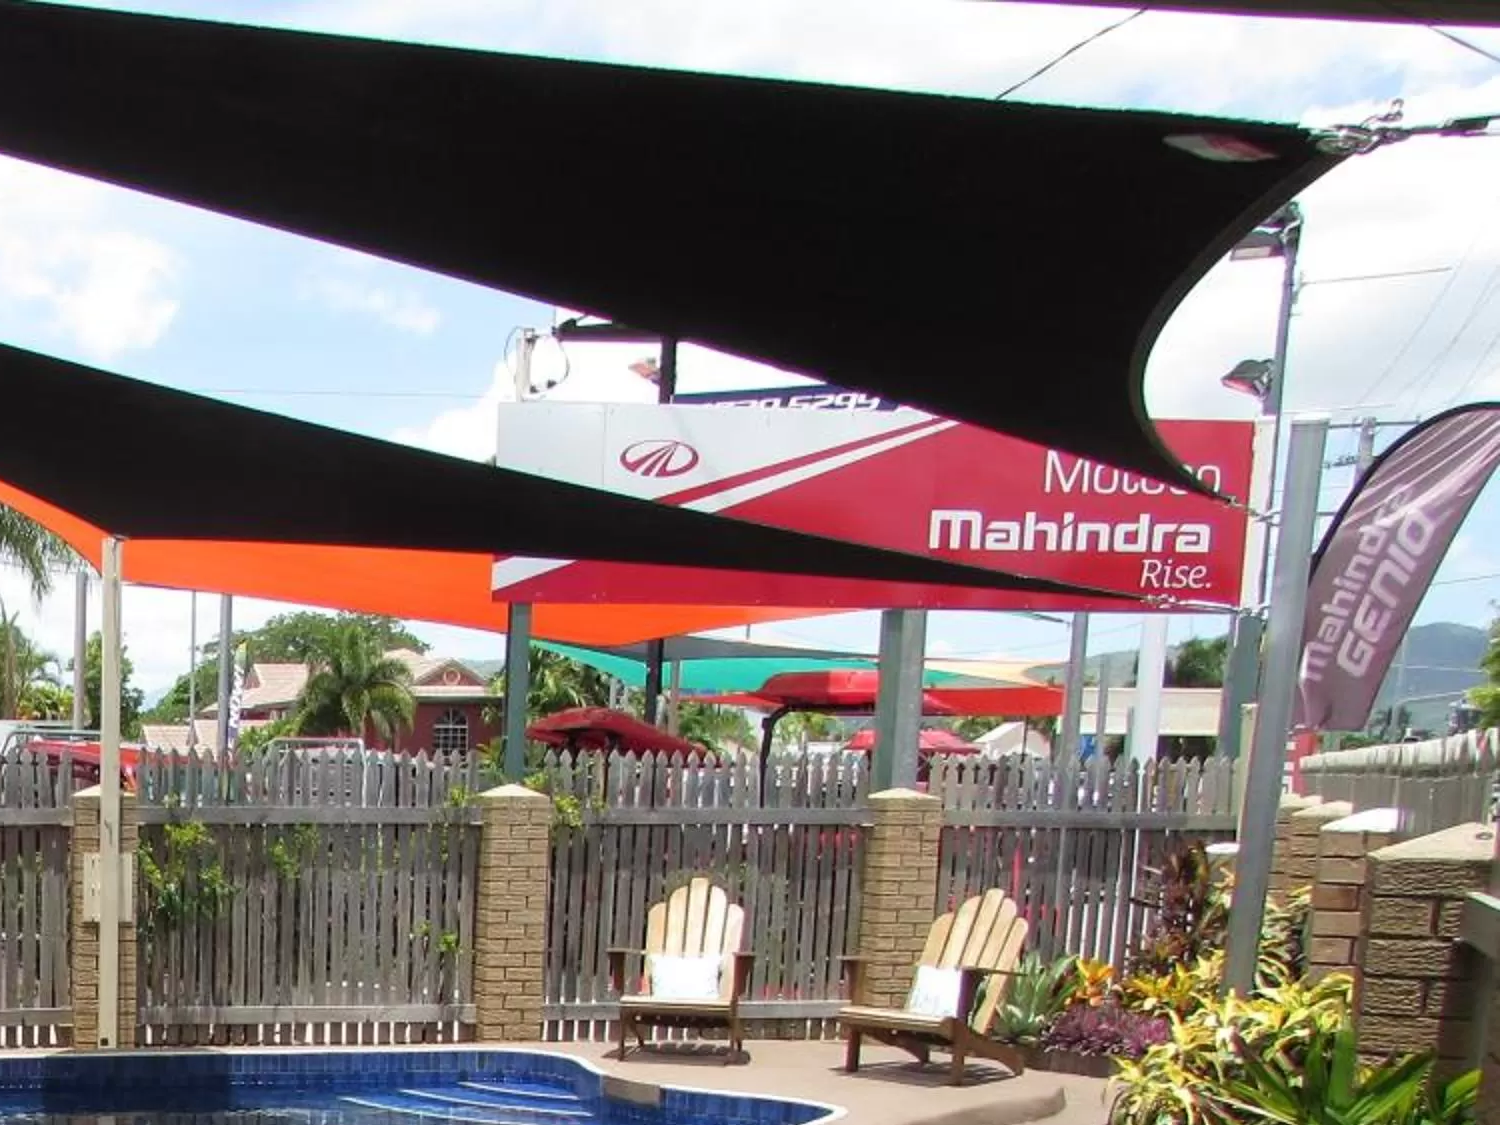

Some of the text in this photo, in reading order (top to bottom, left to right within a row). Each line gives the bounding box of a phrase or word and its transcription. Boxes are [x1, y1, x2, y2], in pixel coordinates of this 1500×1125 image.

[928, 508, 1211, 553] Mahindra
[1140, 559, 1212, 589] Rise.
[1337, 508, 1437, 678] GENIO
